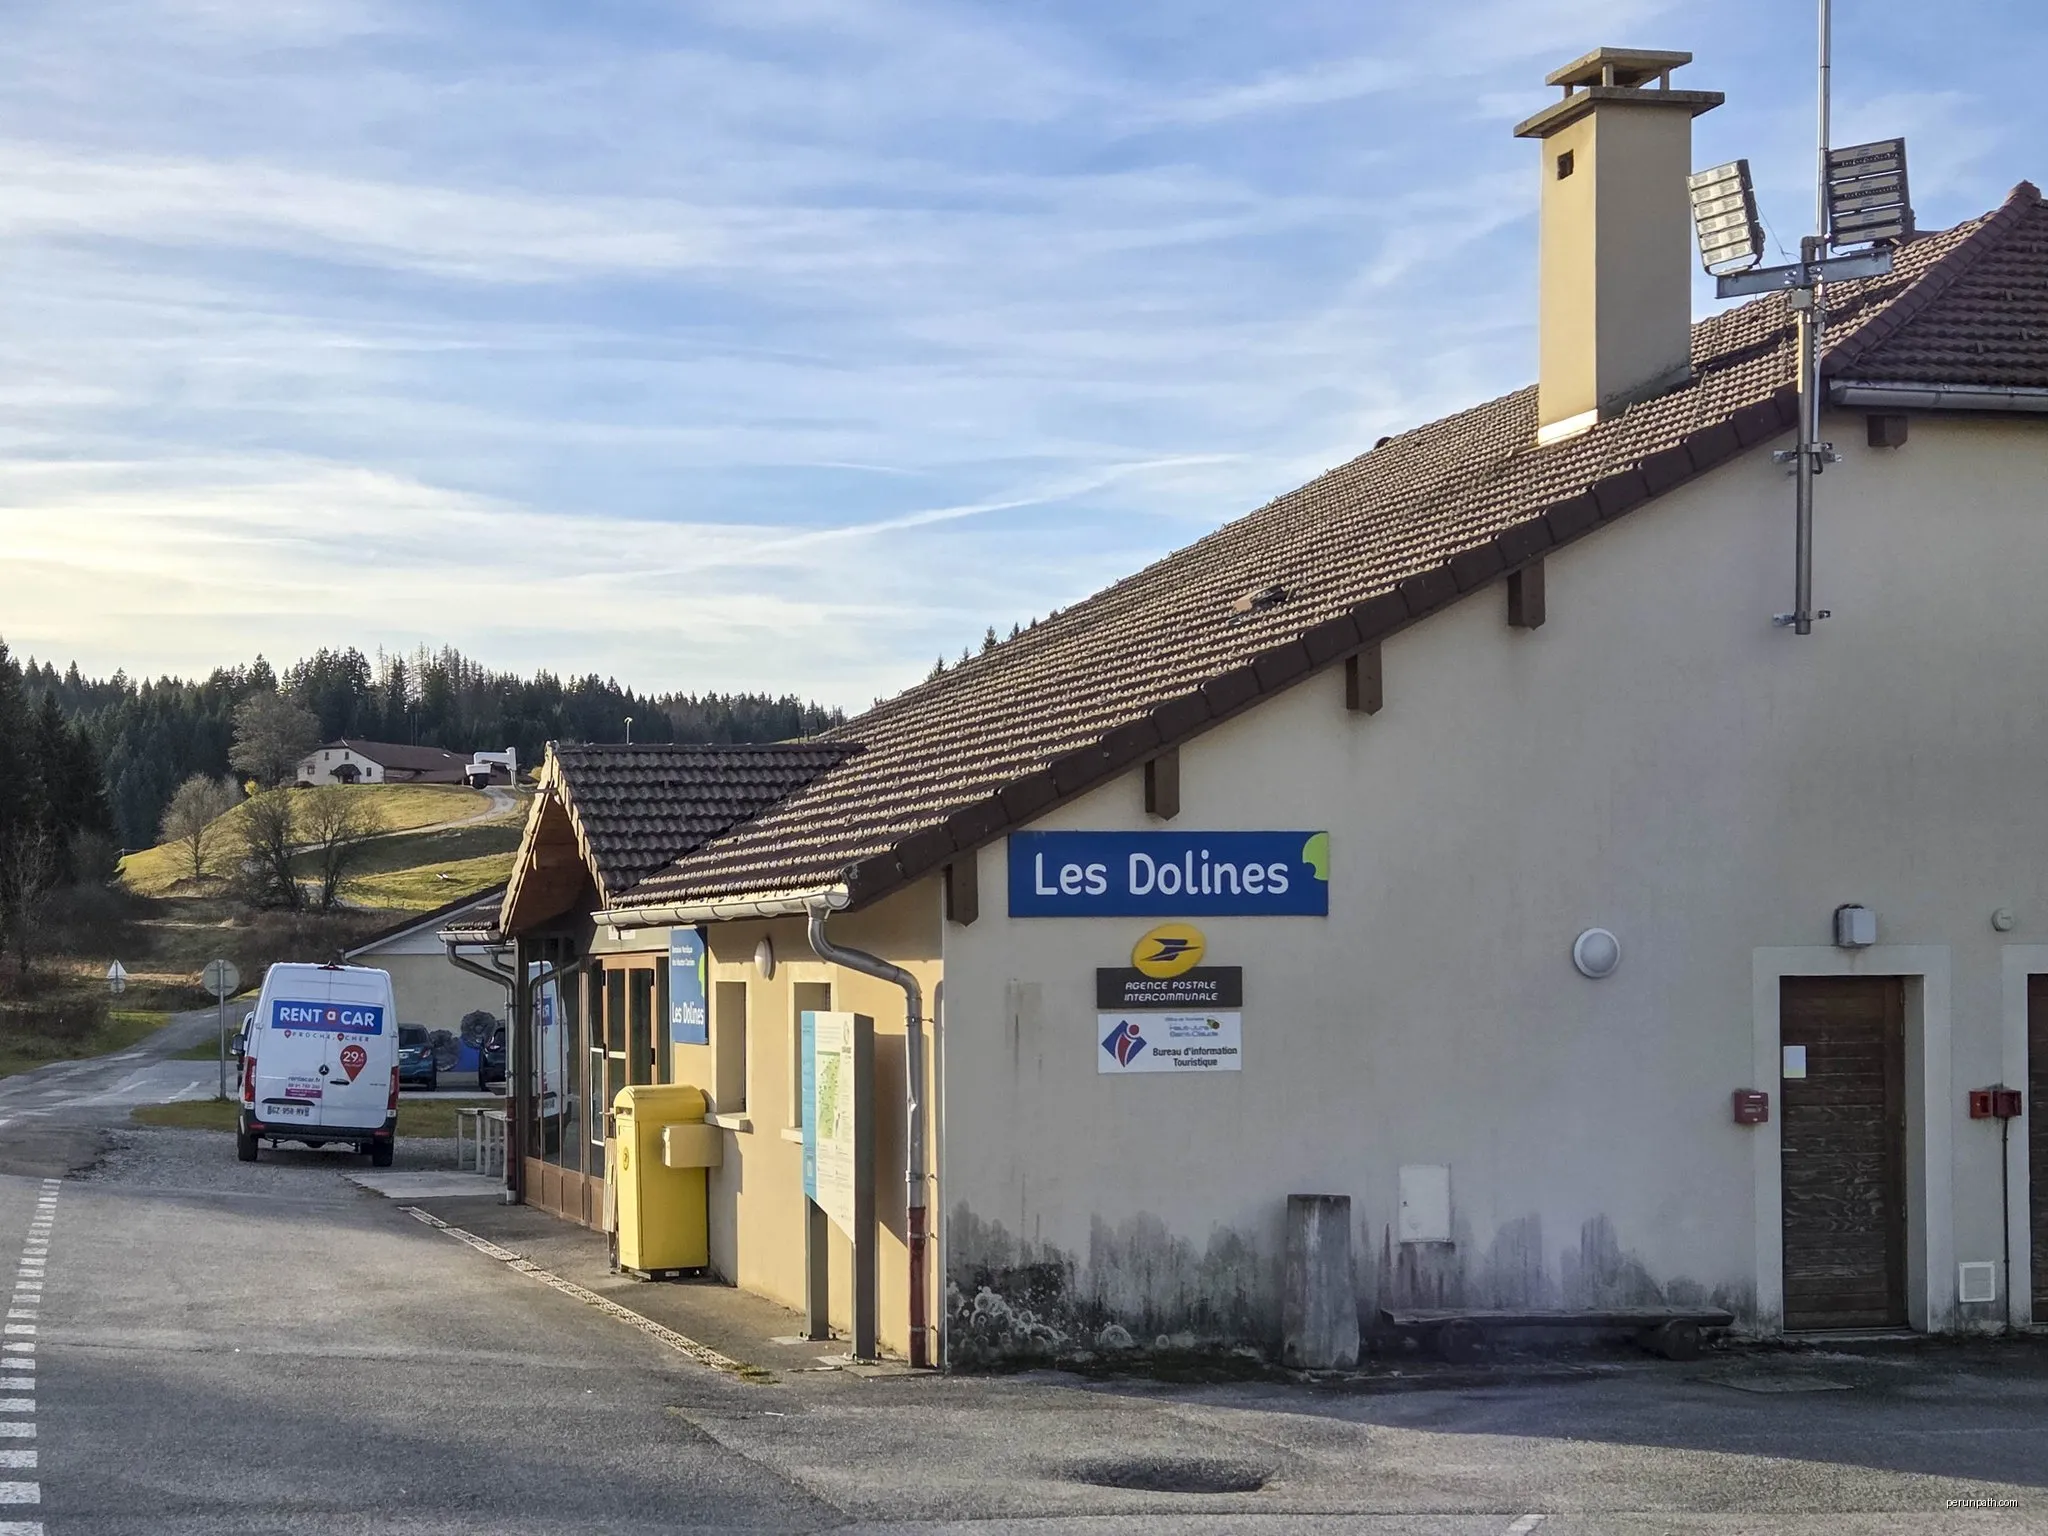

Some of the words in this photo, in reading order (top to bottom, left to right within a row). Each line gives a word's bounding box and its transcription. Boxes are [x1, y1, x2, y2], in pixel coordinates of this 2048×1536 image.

[1035, 852, 1107, 895] Les
[1129, 849, 1289, 895] Dolines
[1125, 981, 1168, 990] AGENCE
[1172, 981, 1217, 990] POSTALE
[1124, 992, 1219, 1002] INTERCOMMUNALE
[280, 1007, 323, 1023] RENT
[340, 1010, 375, 1027] CAR
[1152, 1047, 1181, 1056] Bureau
[1183, 1046, 1237, 1055] d'information
[1173, 1058, 1218, 1067] Touristique
